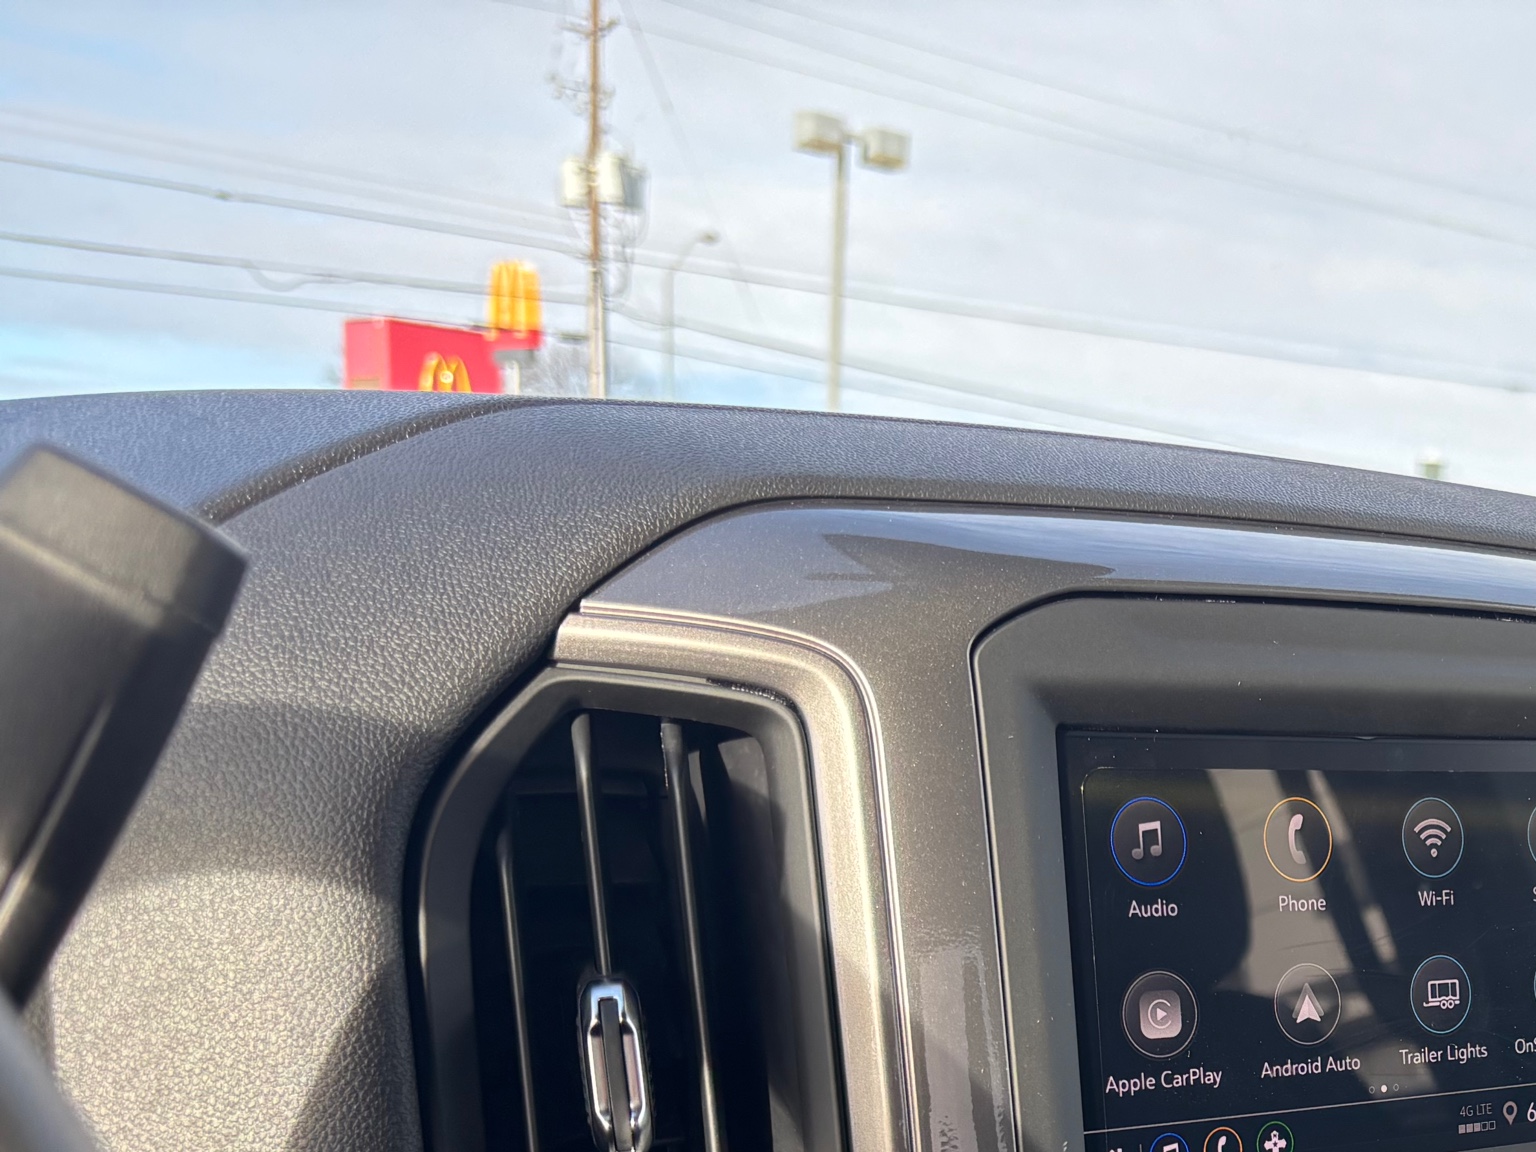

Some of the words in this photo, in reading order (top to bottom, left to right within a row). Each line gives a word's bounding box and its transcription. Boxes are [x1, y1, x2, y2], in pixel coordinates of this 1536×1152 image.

[1278, 894, 1327, 912] Phone
[1418, 889, 1455, 906] Wi-Fi
[1128, 898, 1179, 918] Audio
[1399, 1046, 1443, 1065] Trailer
[1447, 1042, 1488, 1064] Lights
[1261, 1056, 1322, 1079] Android
[1326, 1055, 1361, 1074] Auto
[1105, 1072, 1156, 1098] Apple
[1160, 1066, 1223, 1089] CarPlay
[1459, 1104, 1474, 1117] 4G
[1476, 1103, 1493, 1116] LTE
